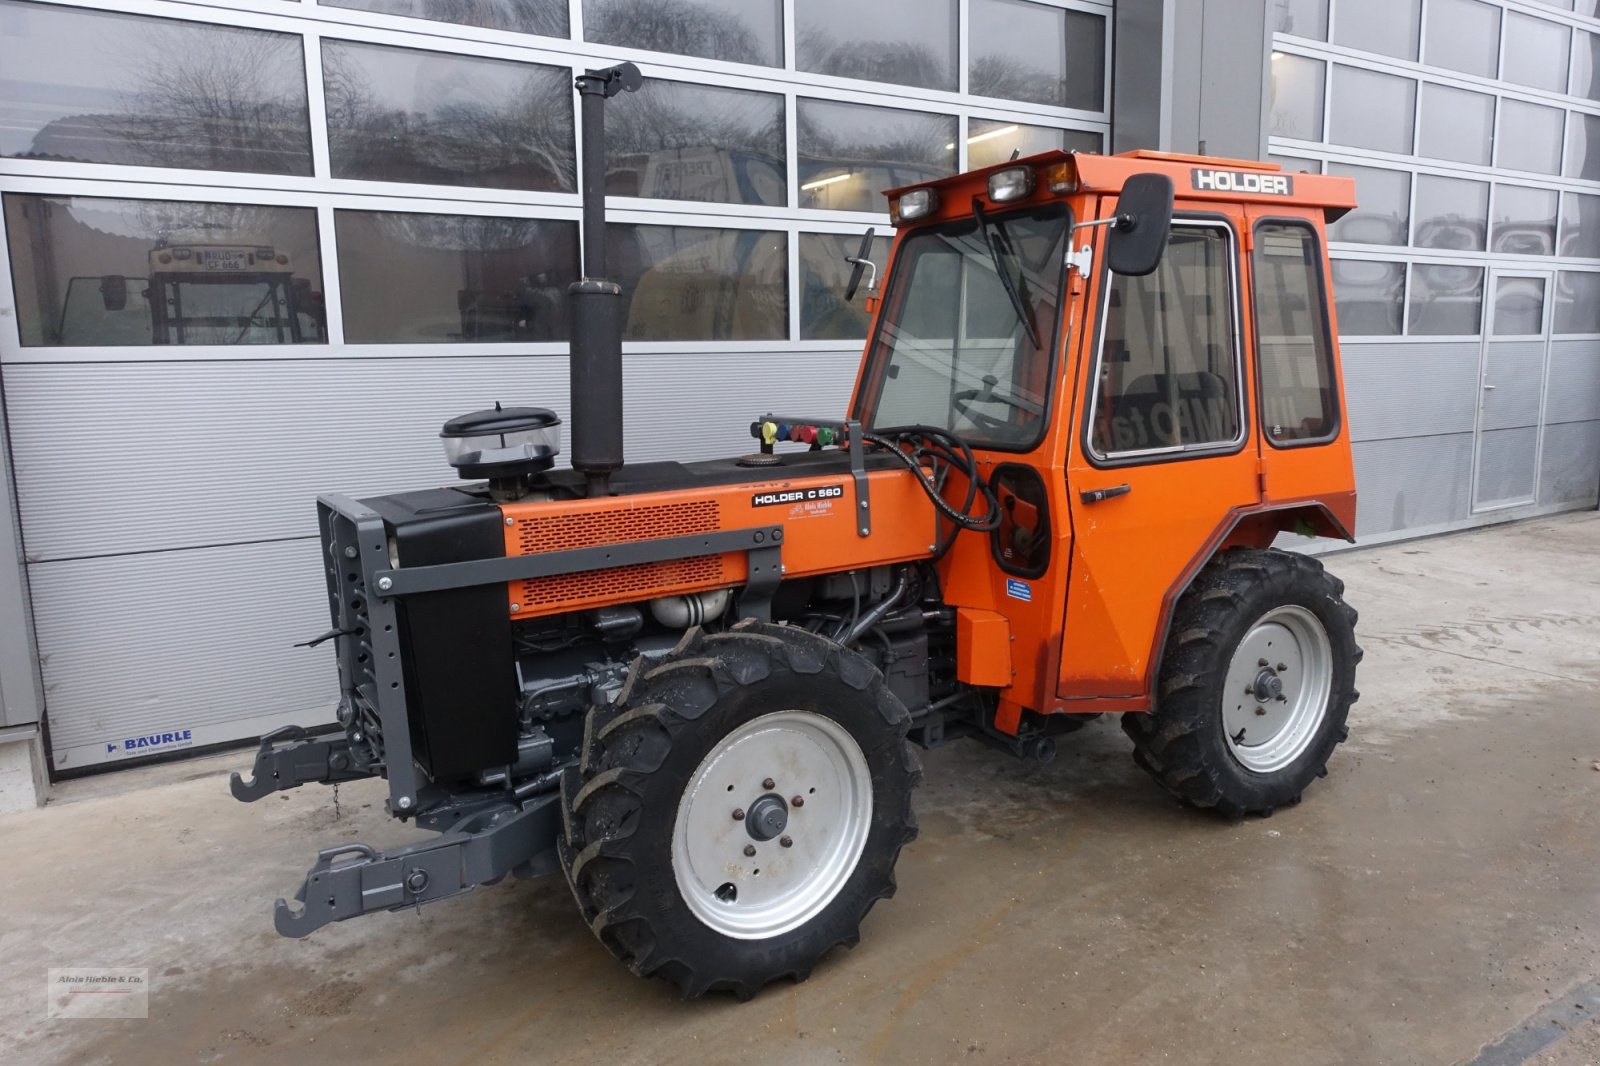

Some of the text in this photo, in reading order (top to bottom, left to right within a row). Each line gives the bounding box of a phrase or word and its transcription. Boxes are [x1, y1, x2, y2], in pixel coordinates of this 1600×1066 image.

[1197, 169, 1288, 195] HOLDER
[755, 487, 841, 504] HOLDER C 560
[124, 729, 192, 750] BÄURLE
